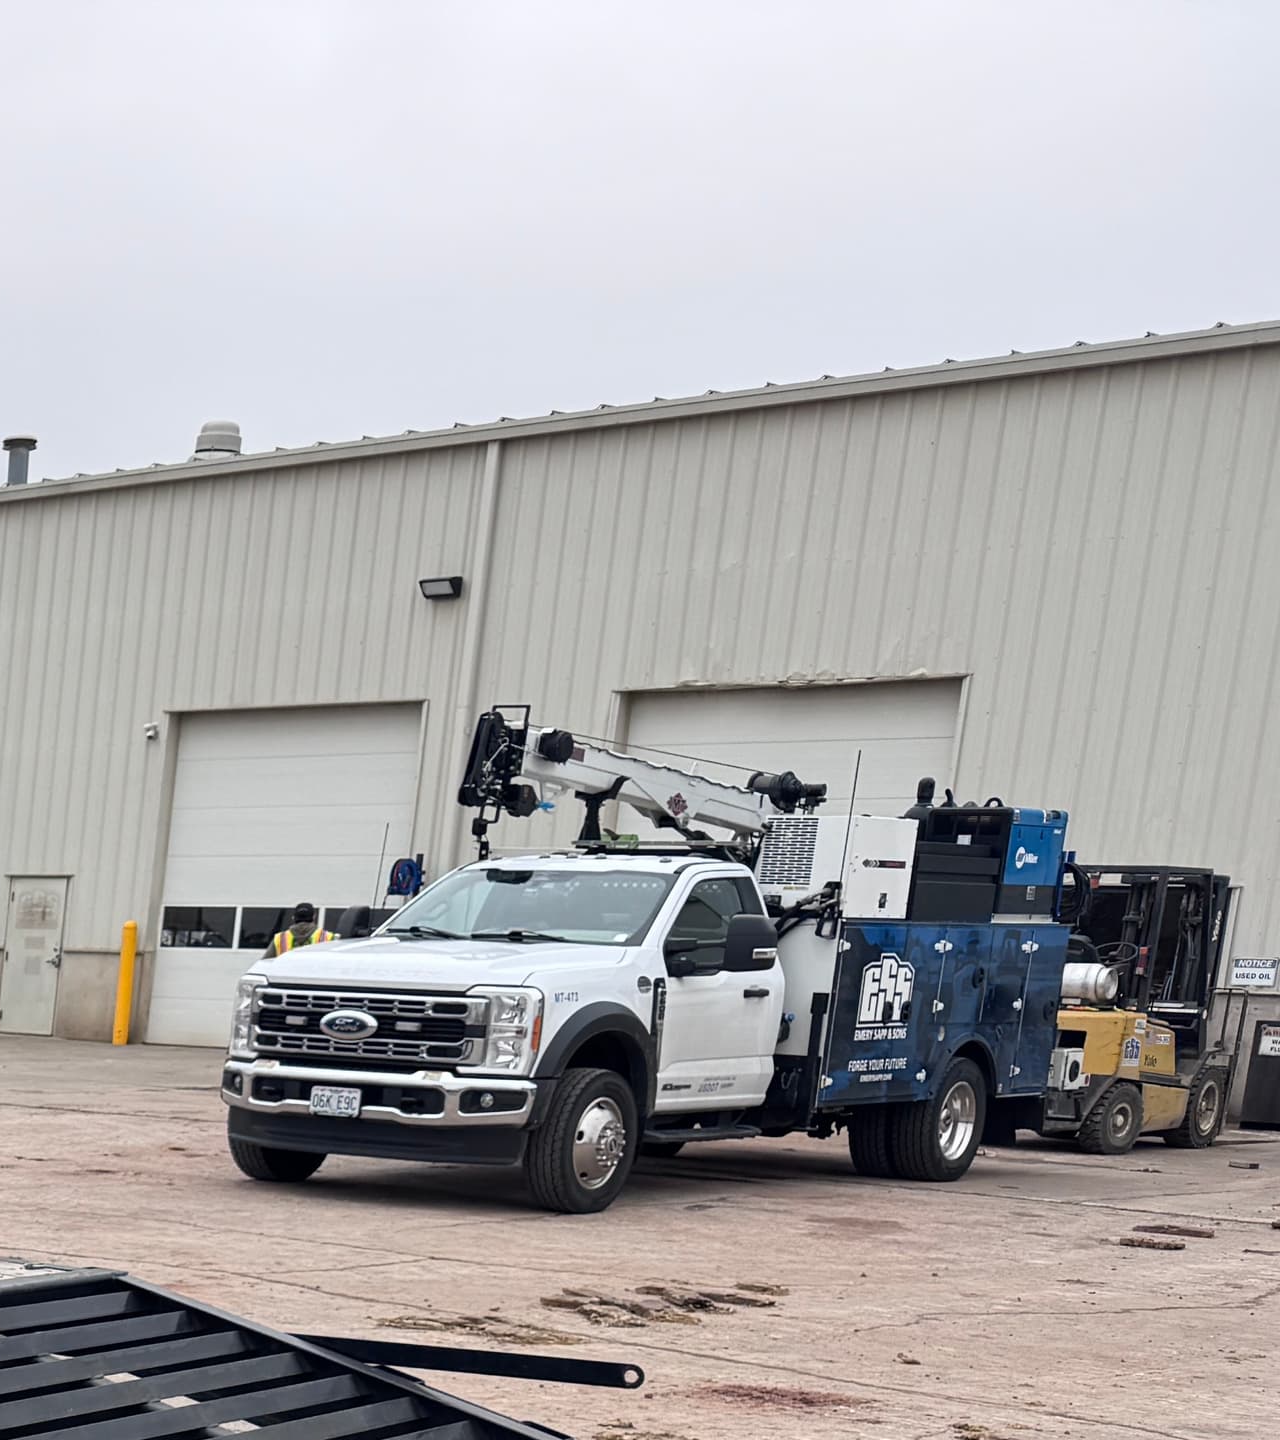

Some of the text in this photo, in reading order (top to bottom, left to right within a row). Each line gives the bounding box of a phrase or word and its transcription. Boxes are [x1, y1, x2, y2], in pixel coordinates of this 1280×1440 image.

[1238, 959, 1274, 968] NOTICE
[860, 958, 913, 1021] ESS
[854, 1029, 873, 1041] EMERY
[873, 1029, 887, 1040] SAPP
[892, 1028, 907, 1039] SONS
[848, 1058, 907, 1072] FORGE YOUR FUTURE
